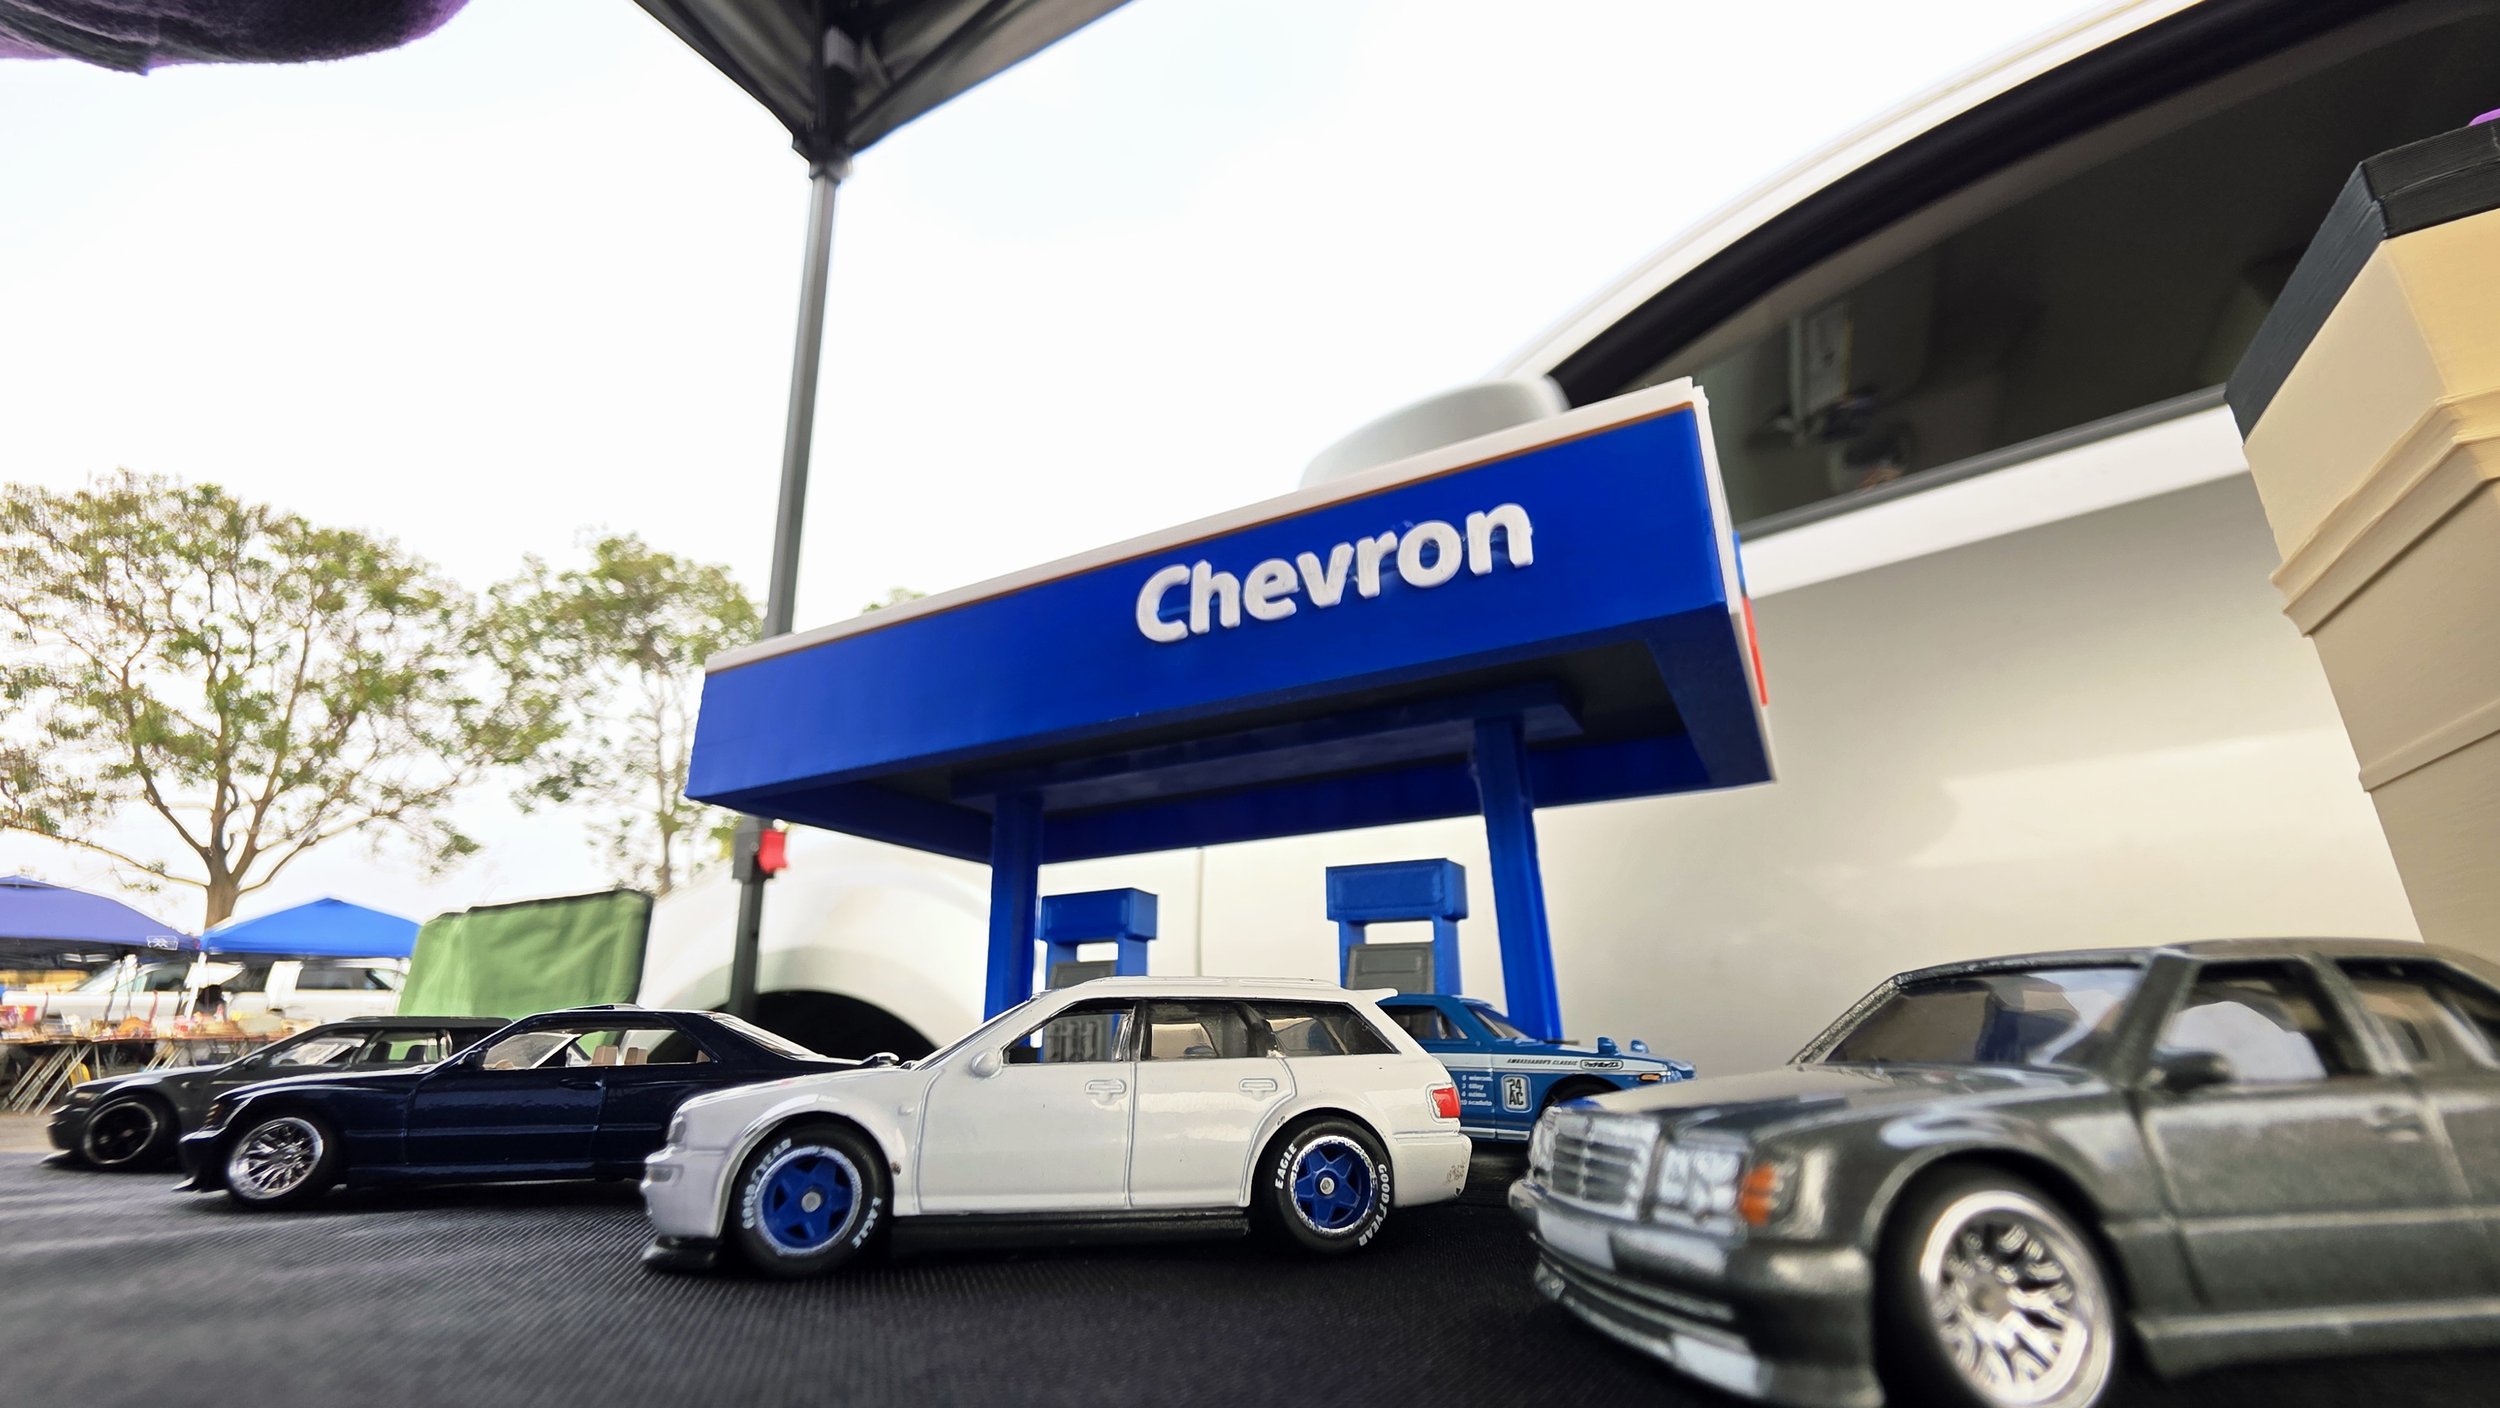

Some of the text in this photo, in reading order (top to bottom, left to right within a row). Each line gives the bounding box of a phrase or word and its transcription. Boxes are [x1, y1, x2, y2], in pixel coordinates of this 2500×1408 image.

[1136, 503, 1534, 643] Chevron
[1508, 1090, 1524, 1106] AC
[1275, 1143, 1297, 1190] EAGLE
[852, 1196, 882, 1248] EAGLE
[1358, 1164, 1390, 1247] GOODYEAR
